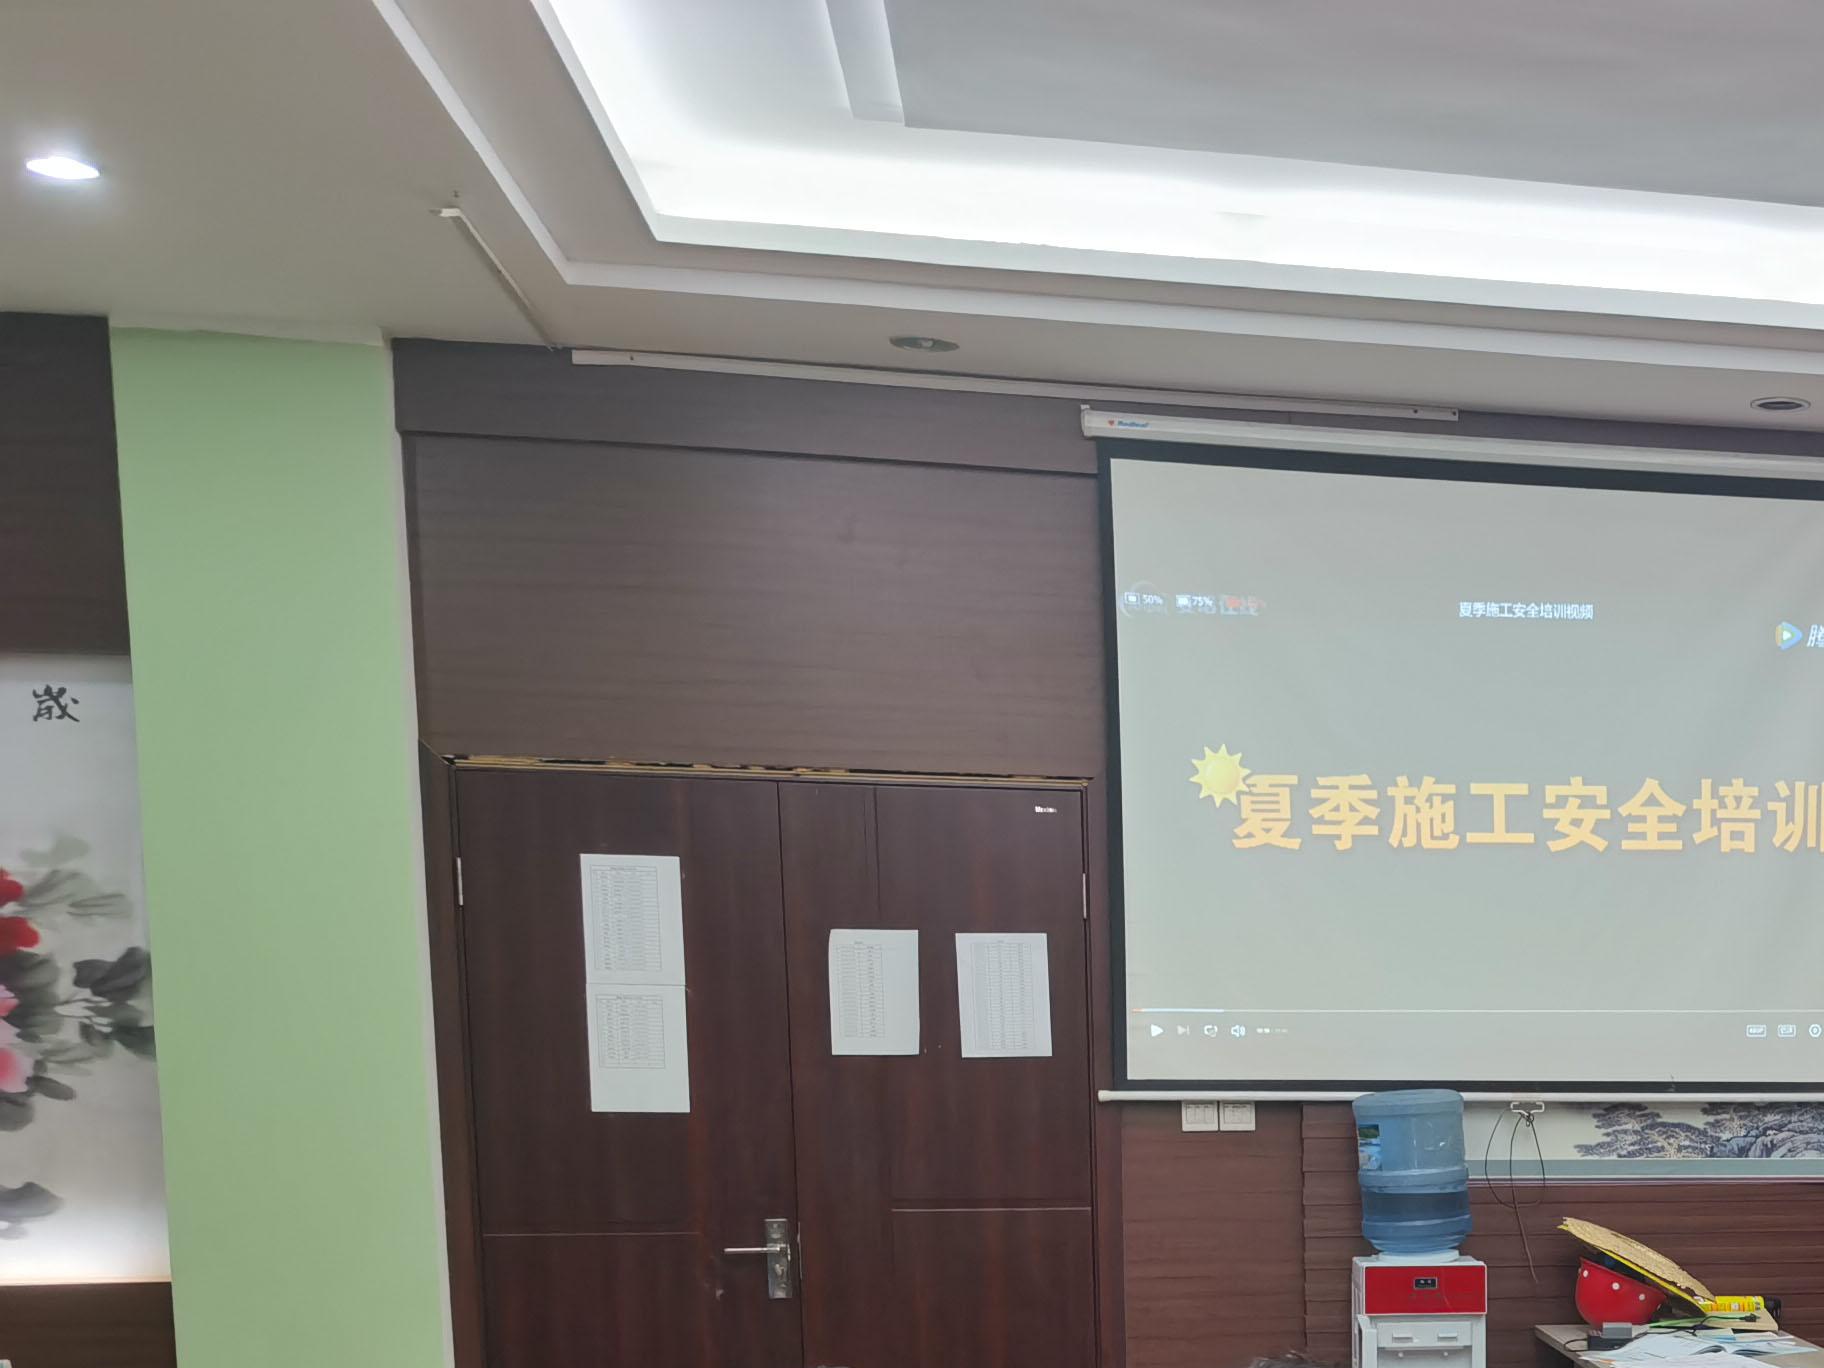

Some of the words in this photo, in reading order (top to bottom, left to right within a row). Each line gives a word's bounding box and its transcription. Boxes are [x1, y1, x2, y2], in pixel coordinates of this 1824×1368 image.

[1459, 602, 1594, 620] 夏季施工安全培训视频
